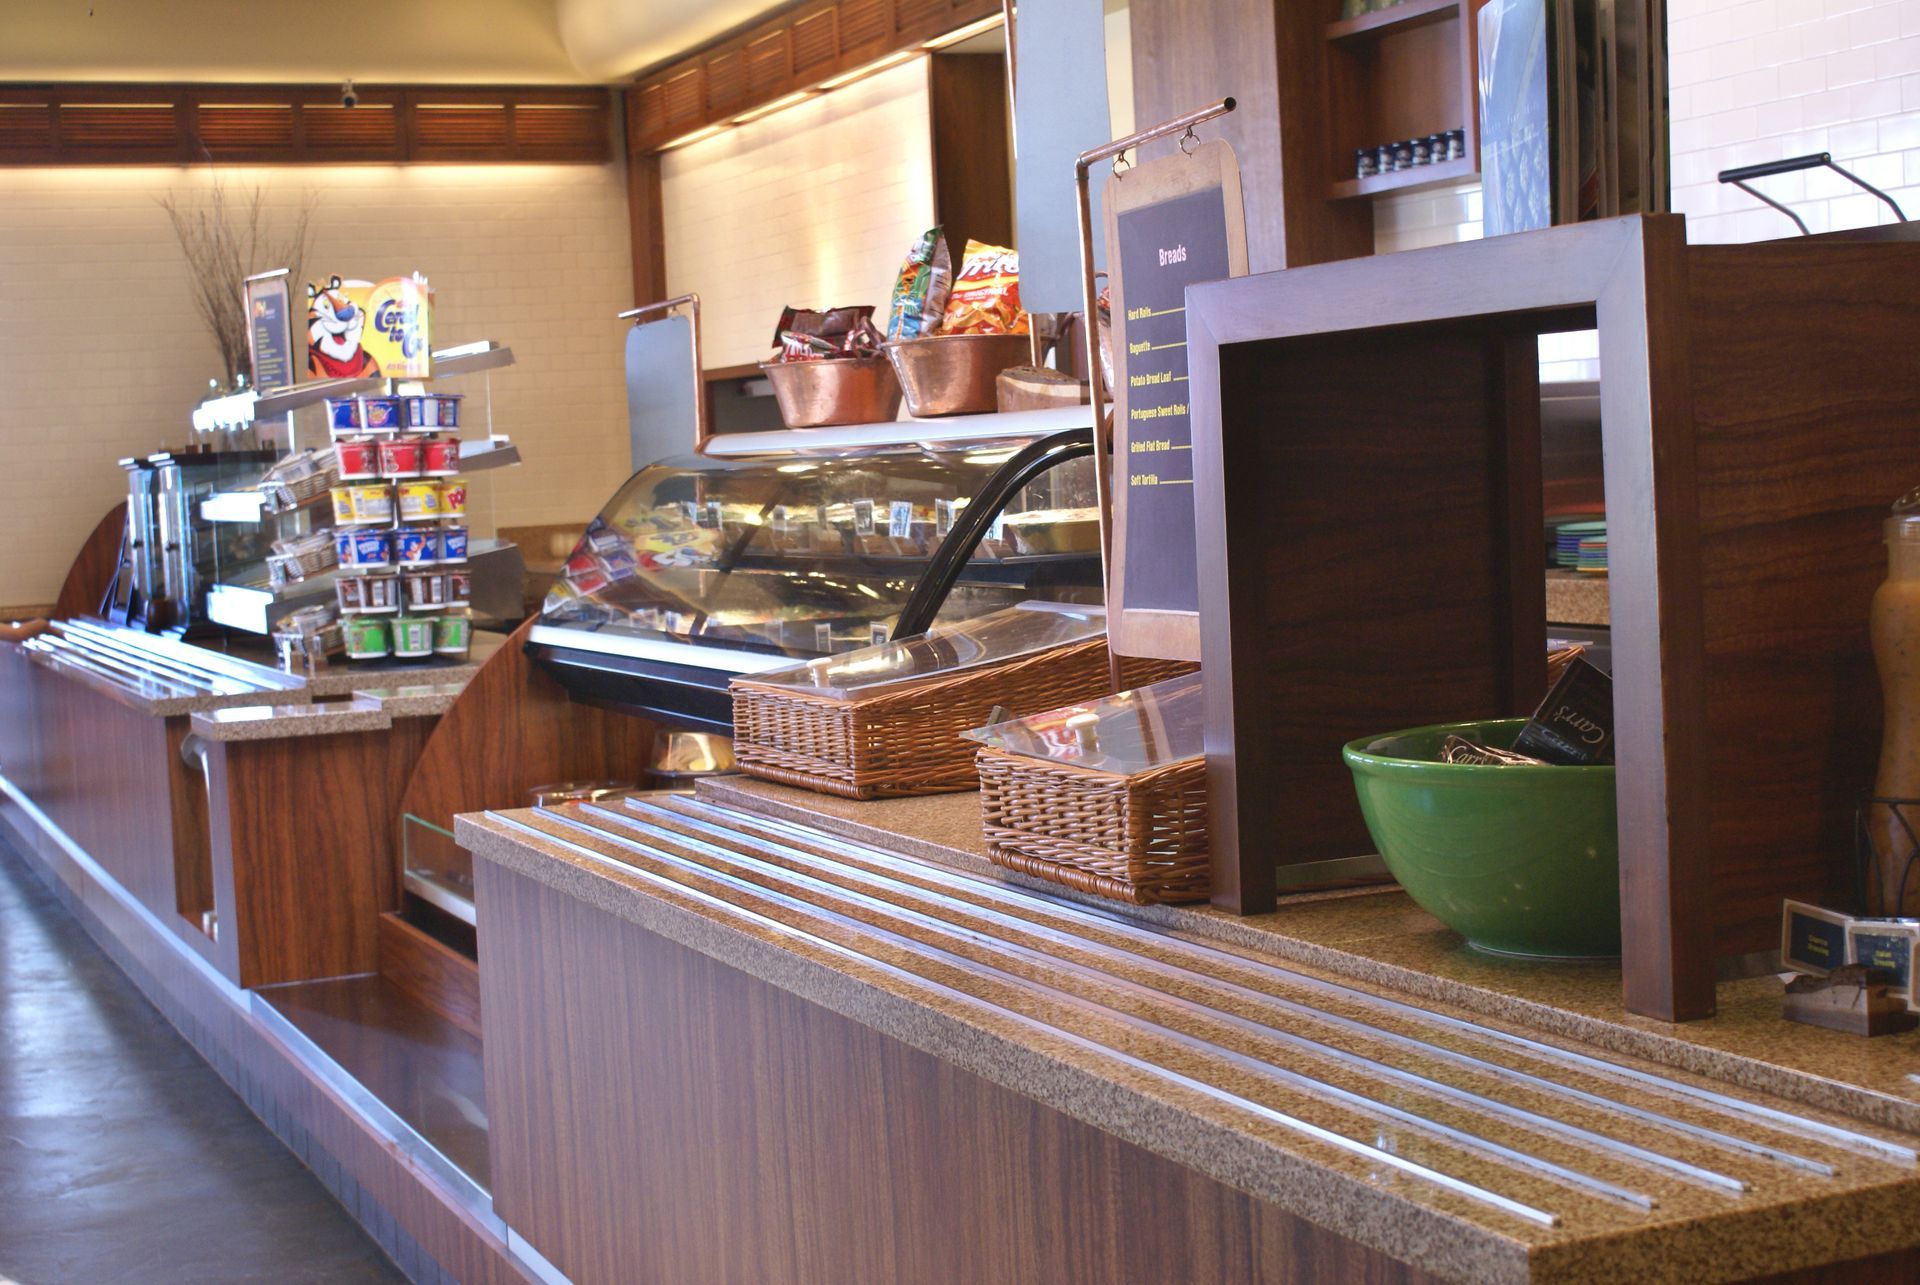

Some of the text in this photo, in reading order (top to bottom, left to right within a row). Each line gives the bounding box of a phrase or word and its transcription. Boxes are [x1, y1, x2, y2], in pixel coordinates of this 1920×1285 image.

[1158, 244, 1187, 267] Breads
[1139, 306, 1152, 319] Rolls
[1129, 341, 1151, 355] Baguette
[1130, 370, 1172, 387] Potato Bread Loaf
[1130, 408, 1157, 421] Portuguese
[1157, 405, 1173, 417] Sweet
[1173, 403, 1186, 415] Rolls
[1130, 439, 1170, 453] Grilled Flat Bread
[1130, 474, 1158, 486] Soft Tortilla
